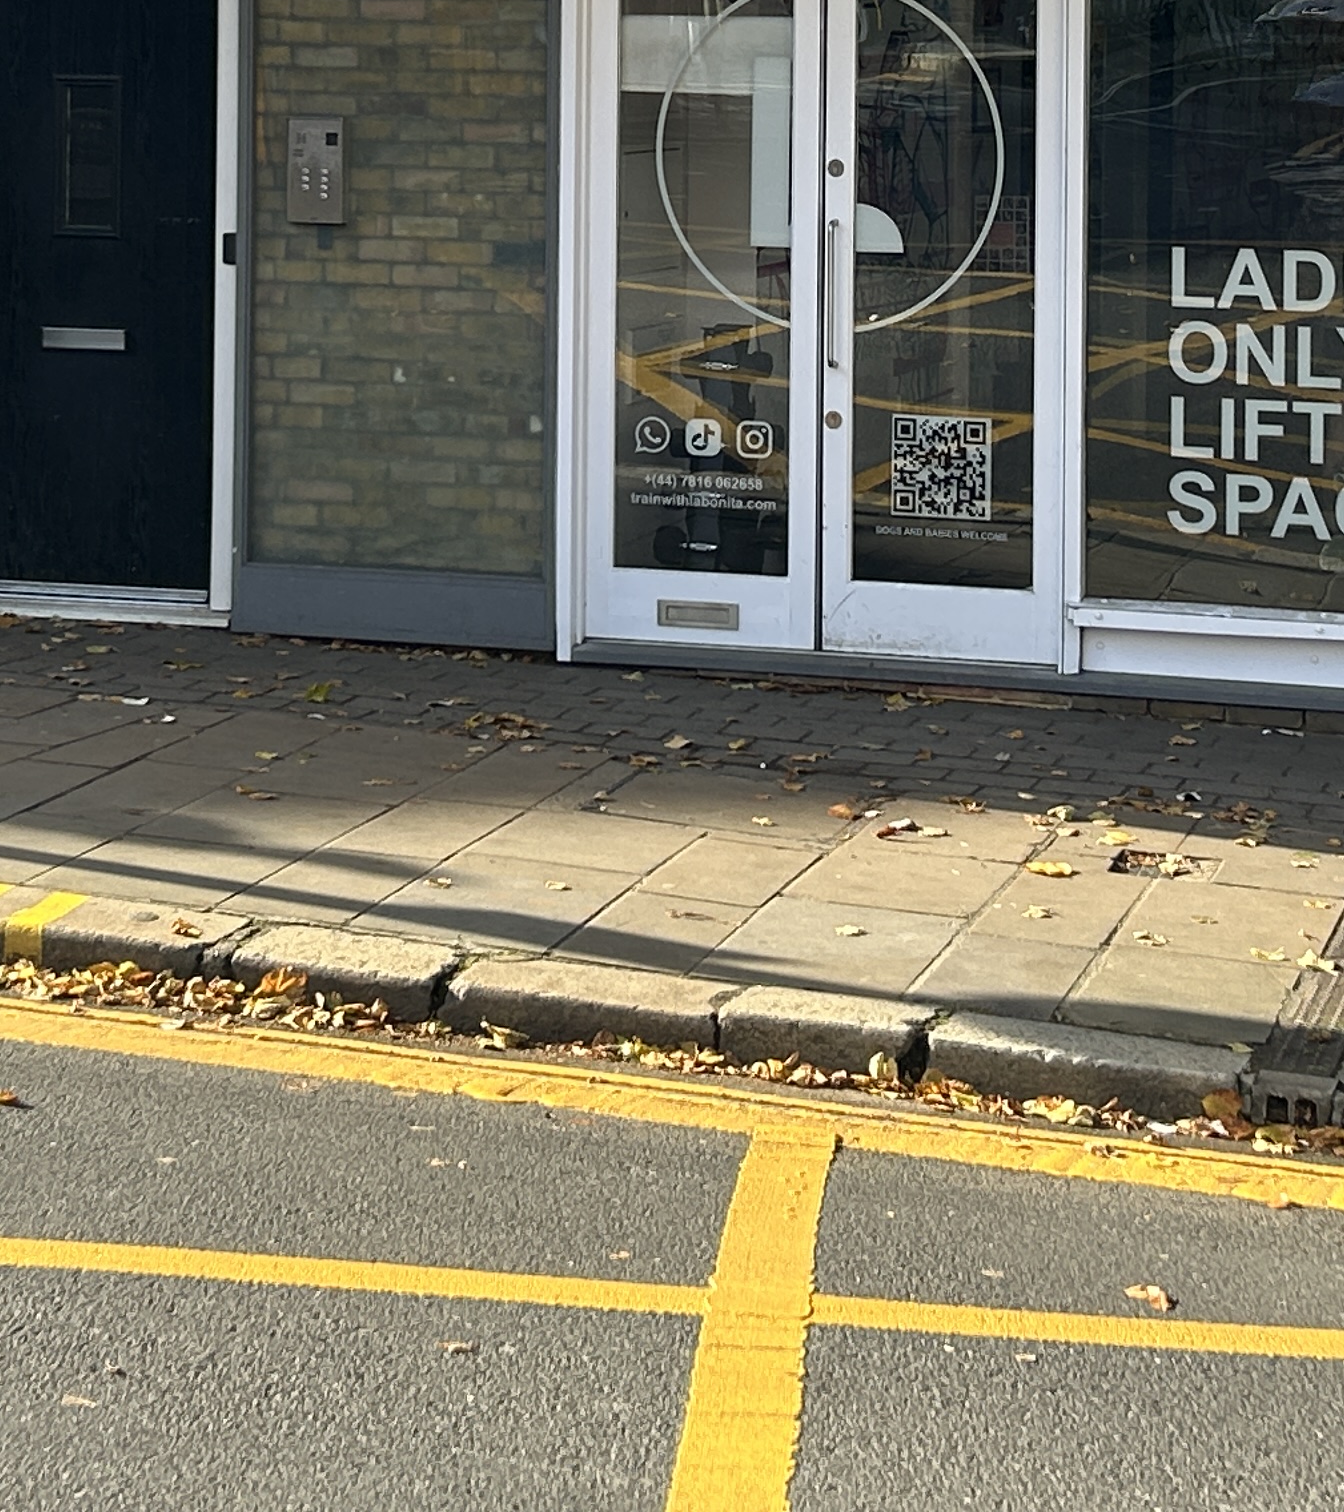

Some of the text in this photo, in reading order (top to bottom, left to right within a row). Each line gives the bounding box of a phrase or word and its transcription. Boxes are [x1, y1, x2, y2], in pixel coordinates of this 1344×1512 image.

[681, 474, 712, 489] 7816
[715, 476, 764, 491] 062658
[630, 492, 777, 511] trainwithlabonita.com
